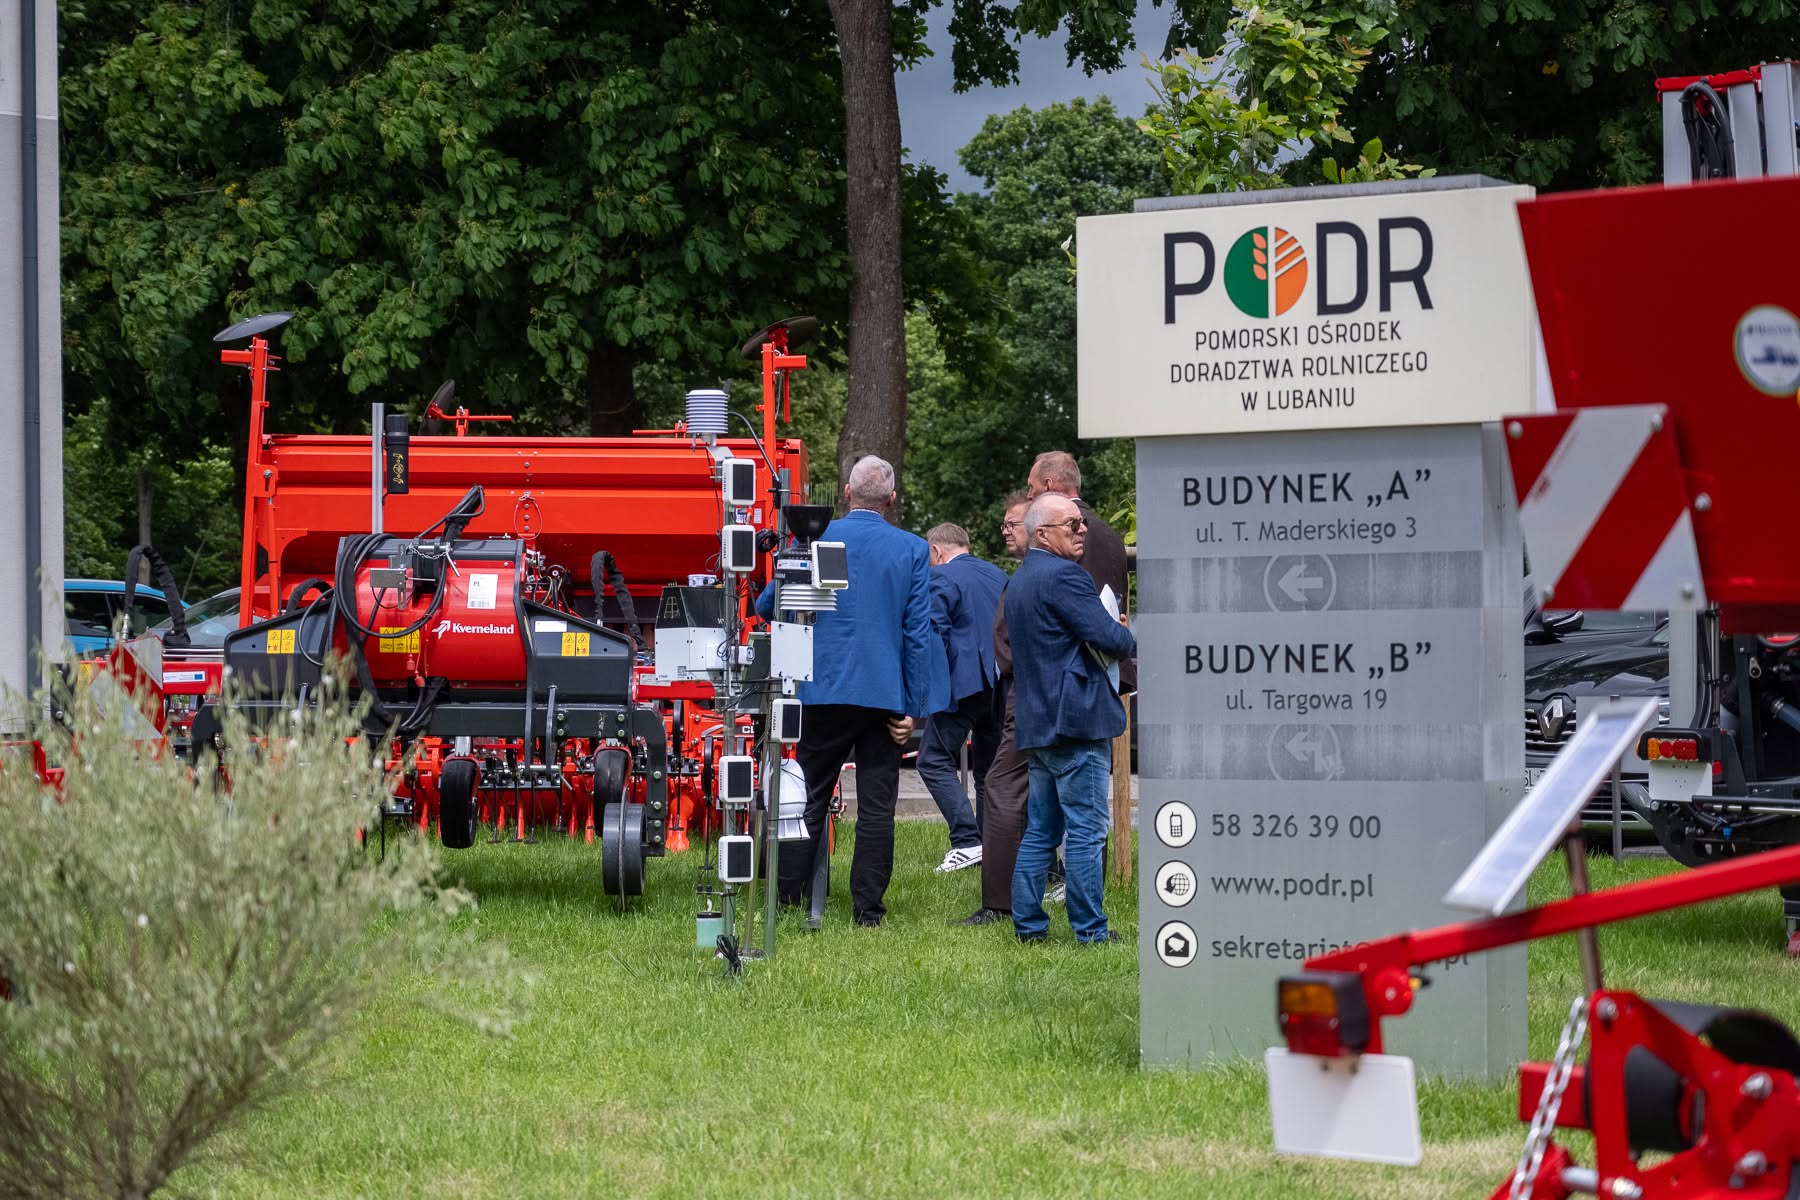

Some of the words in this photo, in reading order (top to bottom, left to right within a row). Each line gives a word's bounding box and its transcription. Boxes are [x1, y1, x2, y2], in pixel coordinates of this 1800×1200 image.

[1196, 327, 1297, 350] POMORSKI
[1308, 320, 1401, 344] OŚRODEK
[1171, 359, 1293, 383] DORADZTWA
[1303, 352, 1427, 376] ROLNICZEGO
[1242, 392, 1257, 411] W
[1268, 387, 1354, 410] LUBANIU
[1184, 472, 1352, 506] BUDYNEK
[1197, 522, 1222, 543] ul.
[1232, 522, 1248, 541] T.
[1259, 518, 1396, 544] Maderskiego
[1406, 517, 1416, 537] 3
[452, 623, 514, 634] Kverneland
[1186, 644, 1355, 673] BUDYNEK
[1227, 689, 1252, 710] ul.
[1262, 690, 1352, 715] Targowa
[1364, 689, 1387, 709] 19
[1213, 814, 1240, 836] 58
[1253, 814, 1297, 837] 326
[1310, 815, 1338, 837] 39
[1350, 816, 1380, 838] 00
[1211, 873, 1373, 902] www.podr.pl
